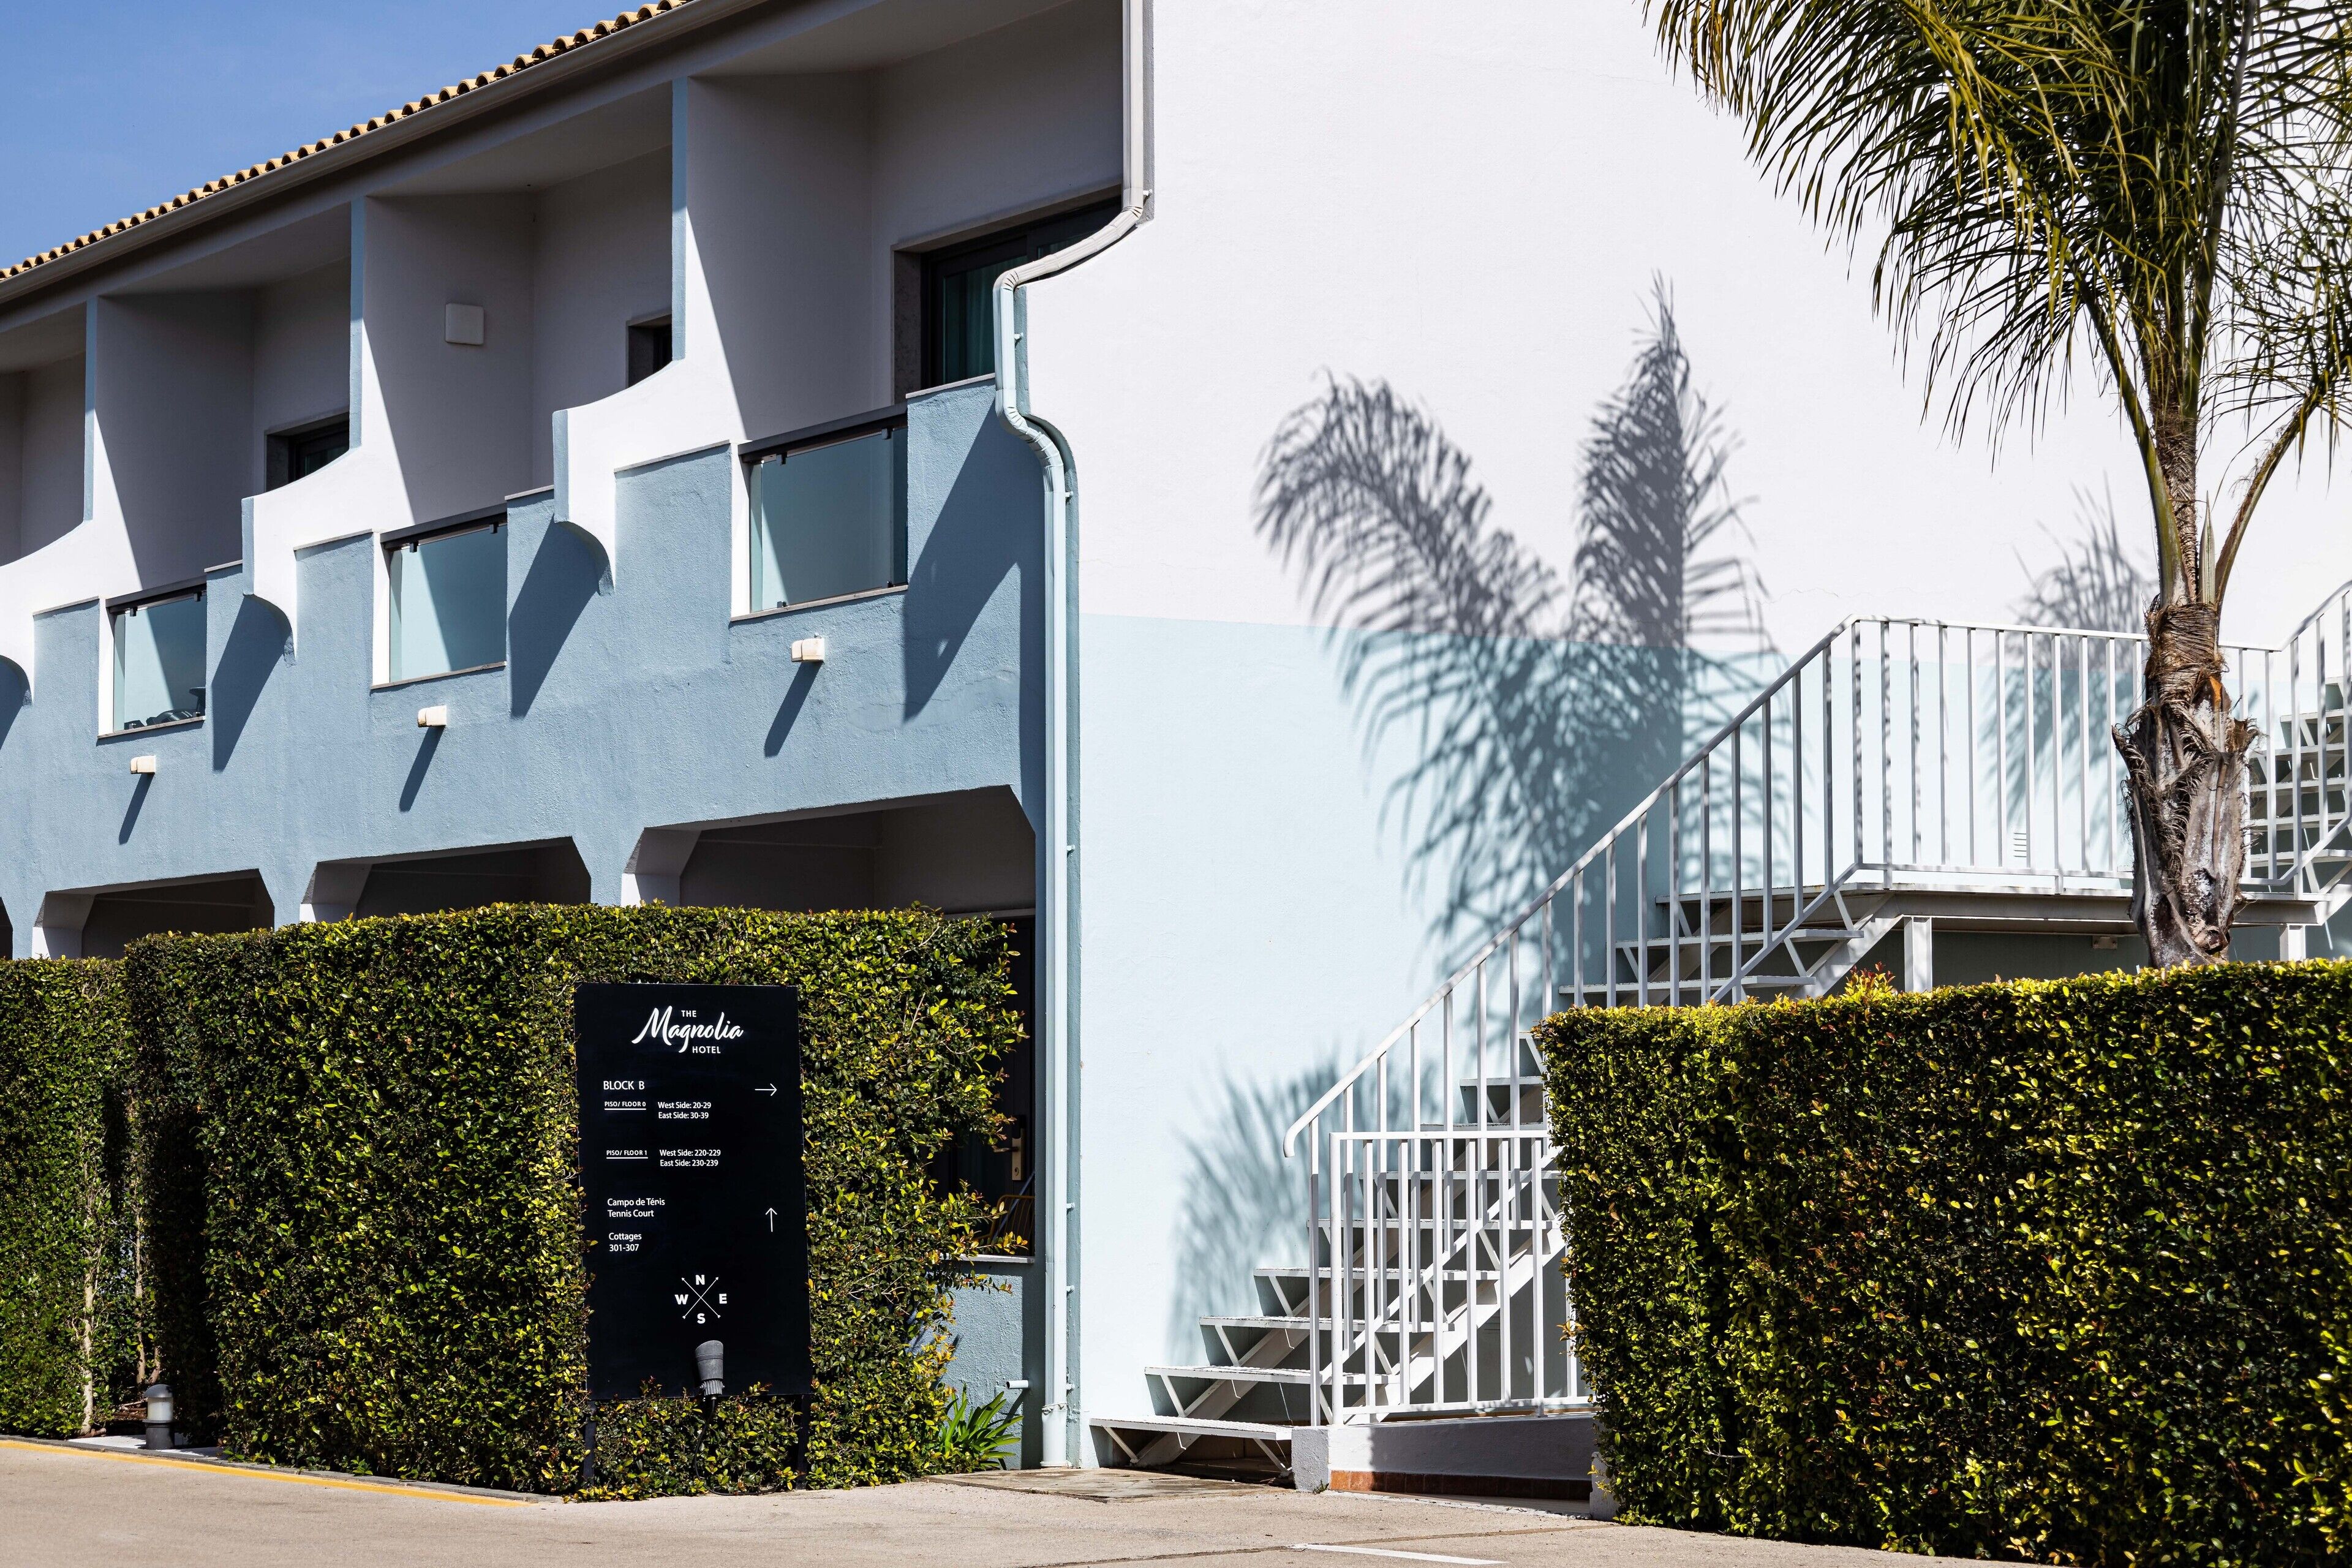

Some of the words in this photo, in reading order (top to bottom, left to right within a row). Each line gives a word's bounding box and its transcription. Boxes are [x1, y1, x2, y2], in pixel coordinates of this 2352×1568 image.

[631, 1005, 744, 1054] Magnolia
[692, 1046, 721, 1054] HOTEL
[603, 1080, 635, 1090] BLOCK
[638, 1080, 645, 1090] B
[607, 1198, 635, 1208] Campo
[635, 1197, 646, 1206] de
[646, 1197, 666, 1206] Ténis
[607, 1209, 632, 1218] Tennis
[633, 1209, 654, 1218] Court
[608, 1232, 642, 1242] Cottages
[609, 1243, 639, 1252] 301-307
[695, 1274, 706, 1286] N
[674, 1294, 689, 1305] W
[718, 1293, 728, 1304] E
[697, 1313, 706, 1324] S
